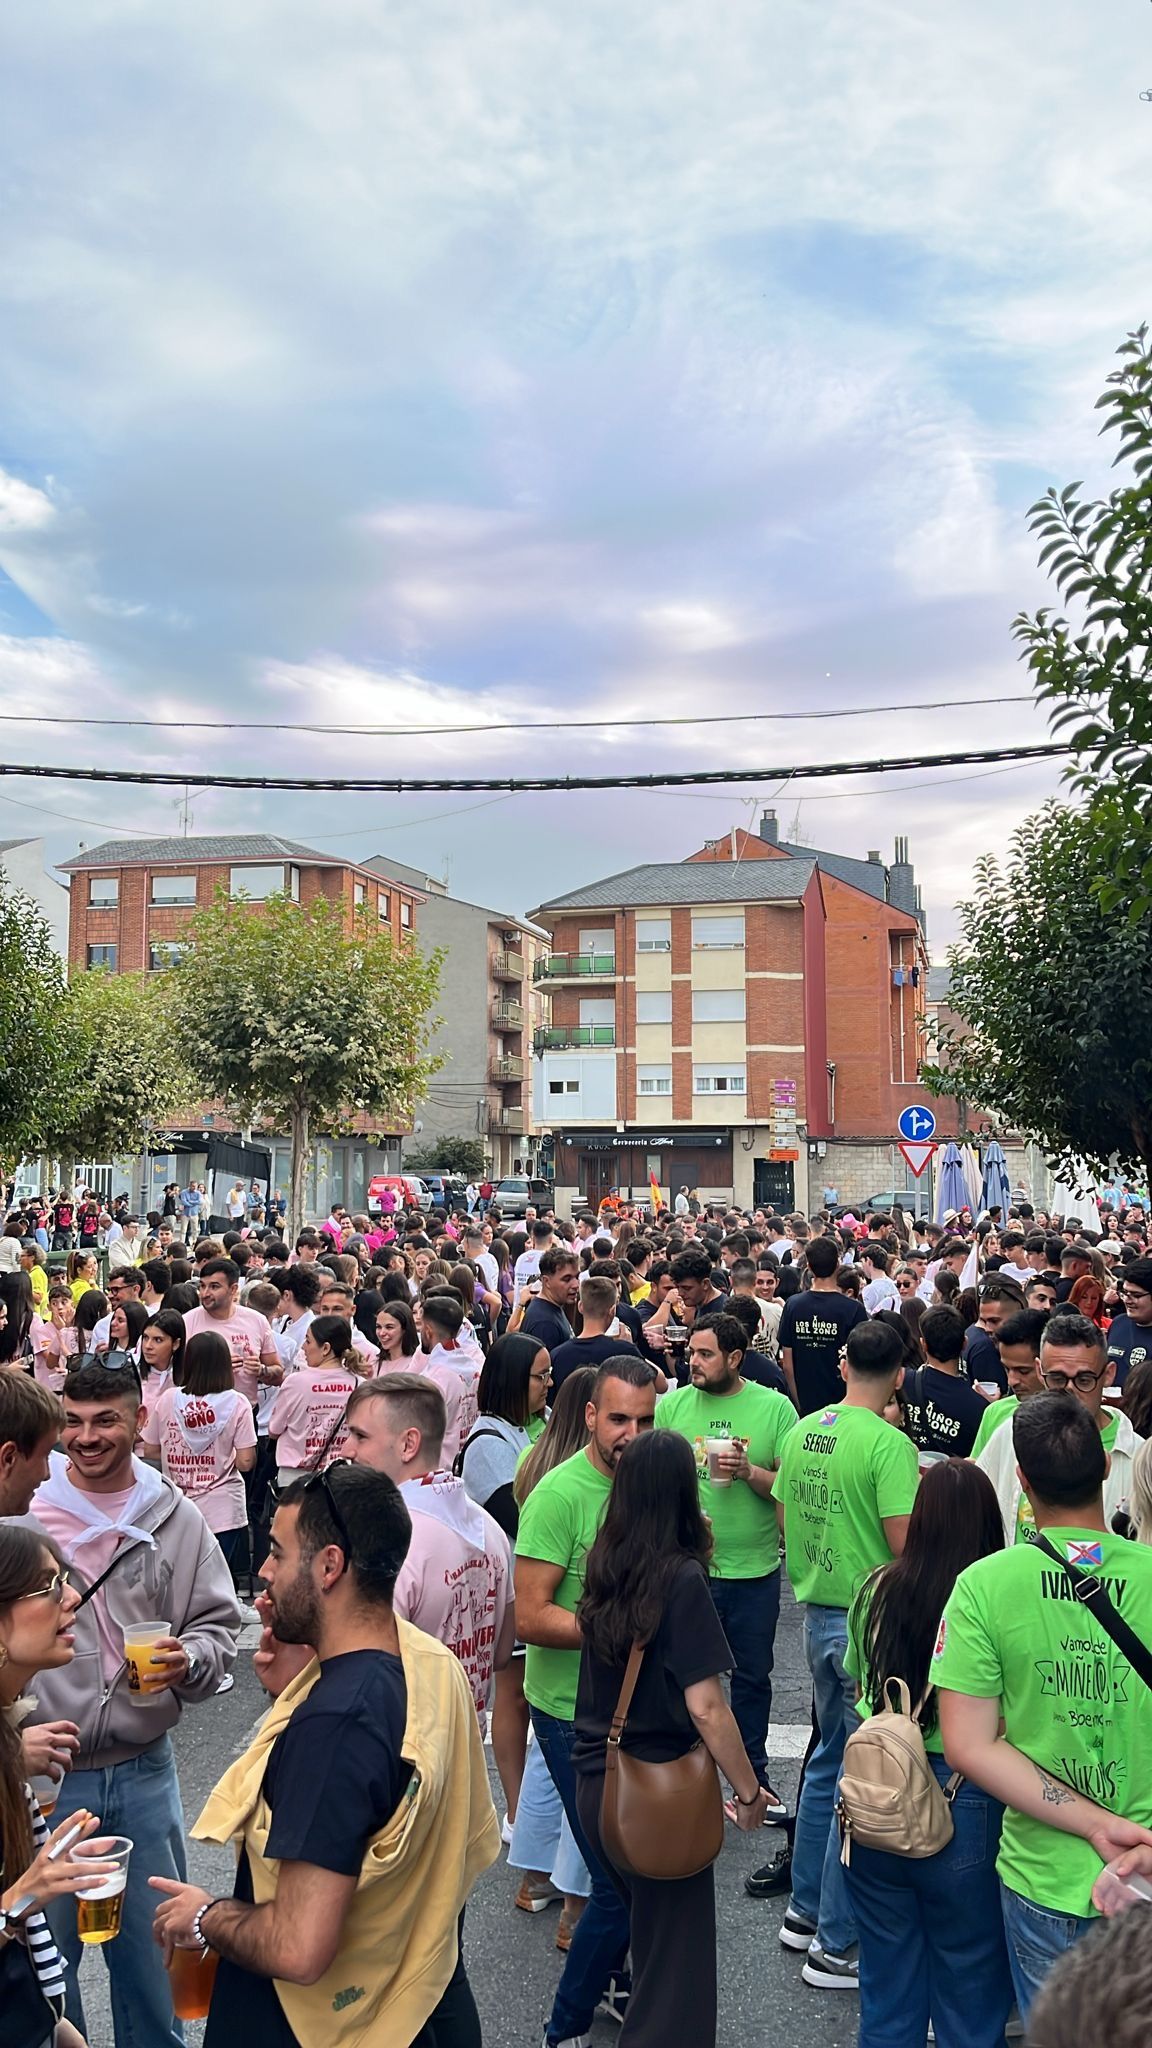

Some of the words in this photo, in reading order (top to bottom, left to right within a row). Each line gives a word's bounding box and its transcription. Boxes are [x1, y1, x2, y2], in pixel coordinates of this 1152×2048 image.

[311, 1384, 353, 1393] CLAUDIA
[907, 1403, 921, 1415] OS
[710, 1419, 732, 1429] PEÑA
[928, 1417, 959, 1438] ONO
[803, 1432, 838, 1455] SERGIO
[1040, 1570, 1128, 1608] IVAKY
[1060, 1634, 1094, 1653] Vamo
